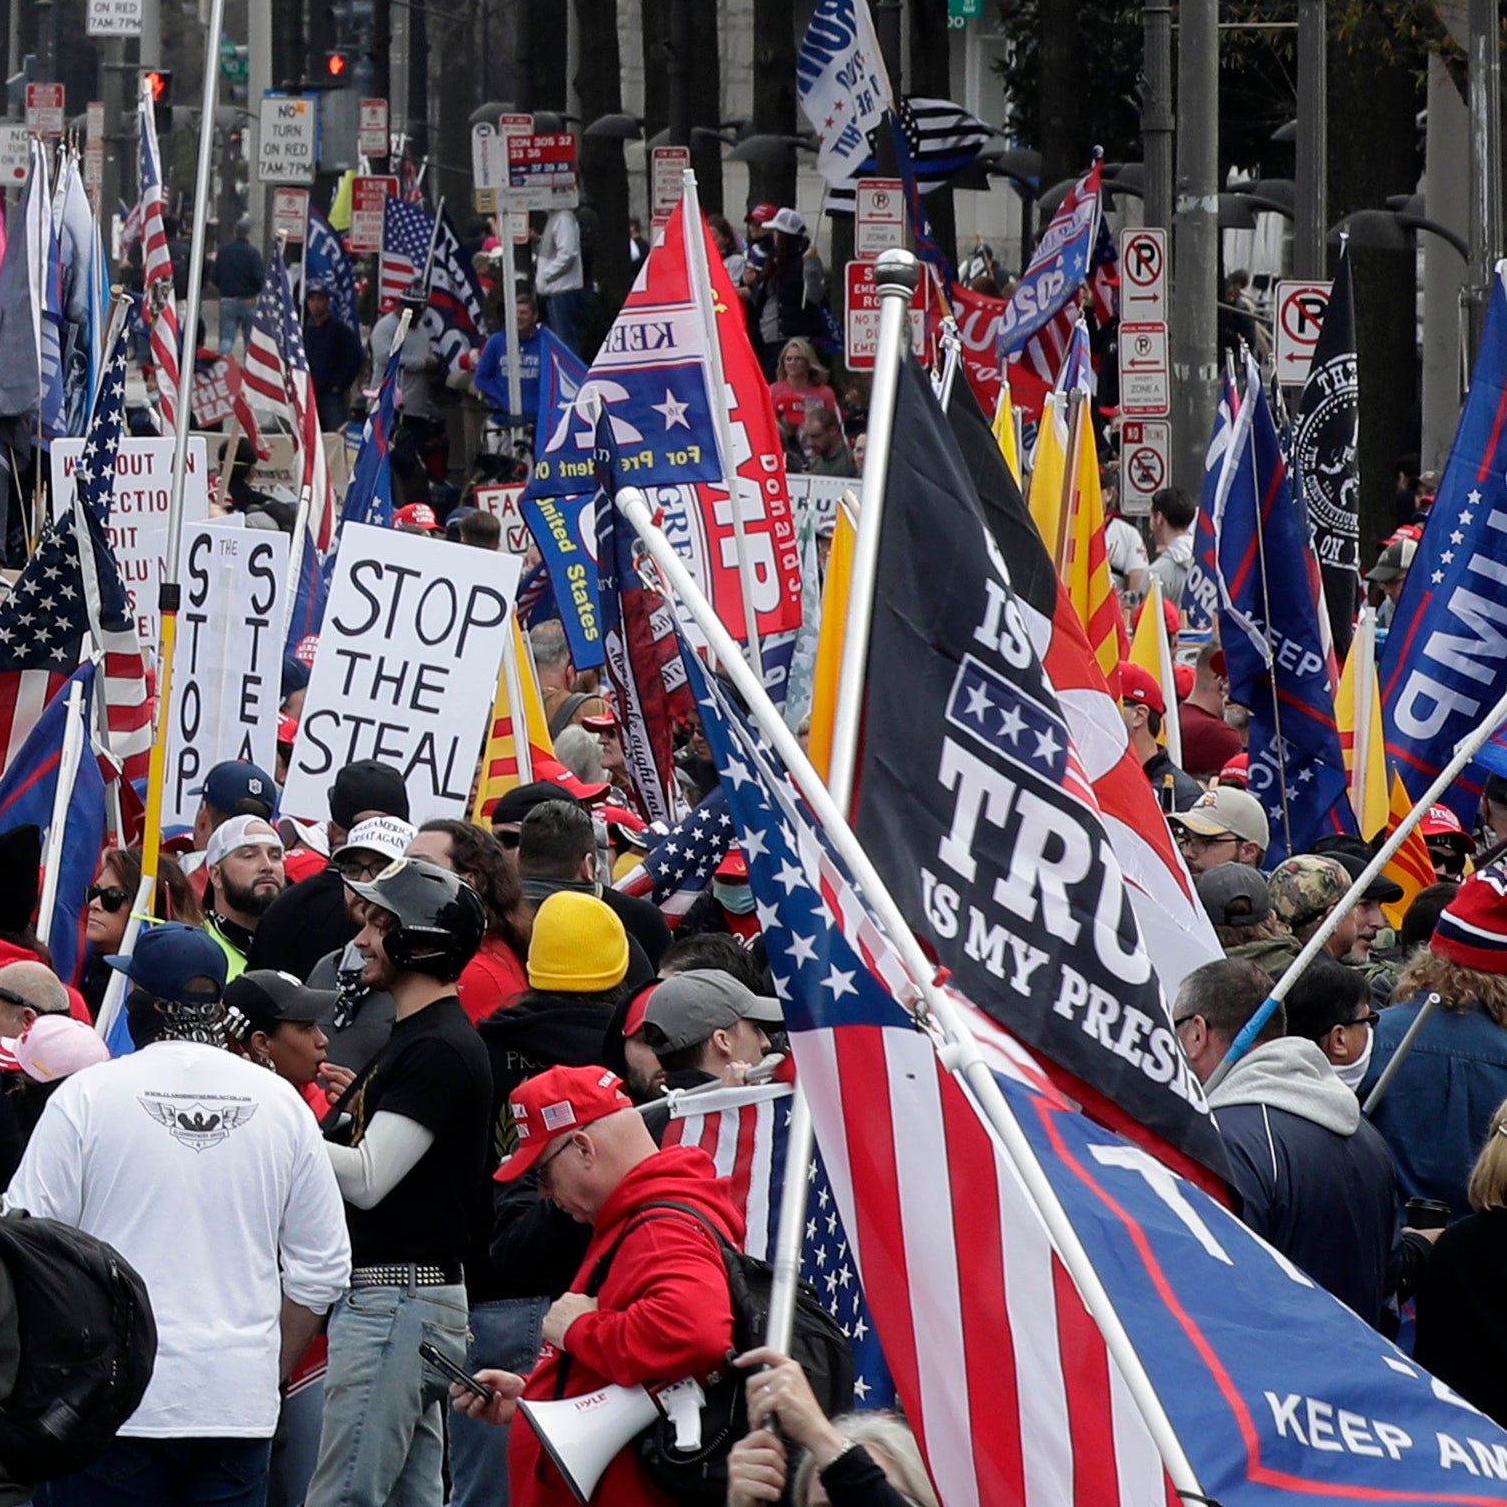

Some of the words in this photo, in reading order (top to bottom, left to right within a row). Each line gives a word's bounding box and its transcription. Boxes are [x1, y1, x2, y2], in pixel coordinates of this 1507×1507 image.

[94, 2, 111, 14] ON
[115, 2, 137, 14] RED
[278, 105, 298, 118] NO
[272, 124, 303, 138] TURN
[558, 135, 573, 147] 32
[264, 143, 281, 156] ON
[285, 143, 309, 157] RED
[866, 234, 888, 243] ZONE
[854, 314, 870, 325] NO
[1130, 384, 1152, 394] ZONE
[1152, 384, 1160, 394] A
[1126, 427, 1141, 441] NO
[63, 452, 155, 477] WOUT
[759, 453, 801, 571] Donald
[788, 575, 802, 602] J.
[219, 538, 240, 557] THE
[1318, 535, 1346, 561] ON
[536, 497, 578, 555] United
[566, 563, 601, 643] States
[330, 558, 508, 660] STOP
[973, 584, 1033, 671] IS
[335, 648, 451, 717] THE
[295, 708, 469, 804] STEAL
[644, 788, 664, 819] not
[350, 831, 376, 846] GREAT
[376, 832, 405, 850] AGAIN
[373, 818, 415, 841] AMERICA
[919, 866, 960, 939] IS
[965, 905, 1049, 997] MY
[574, 1391, 609, 1412] PYLE
[1263, 1391, 1414, 1461] KEEP
